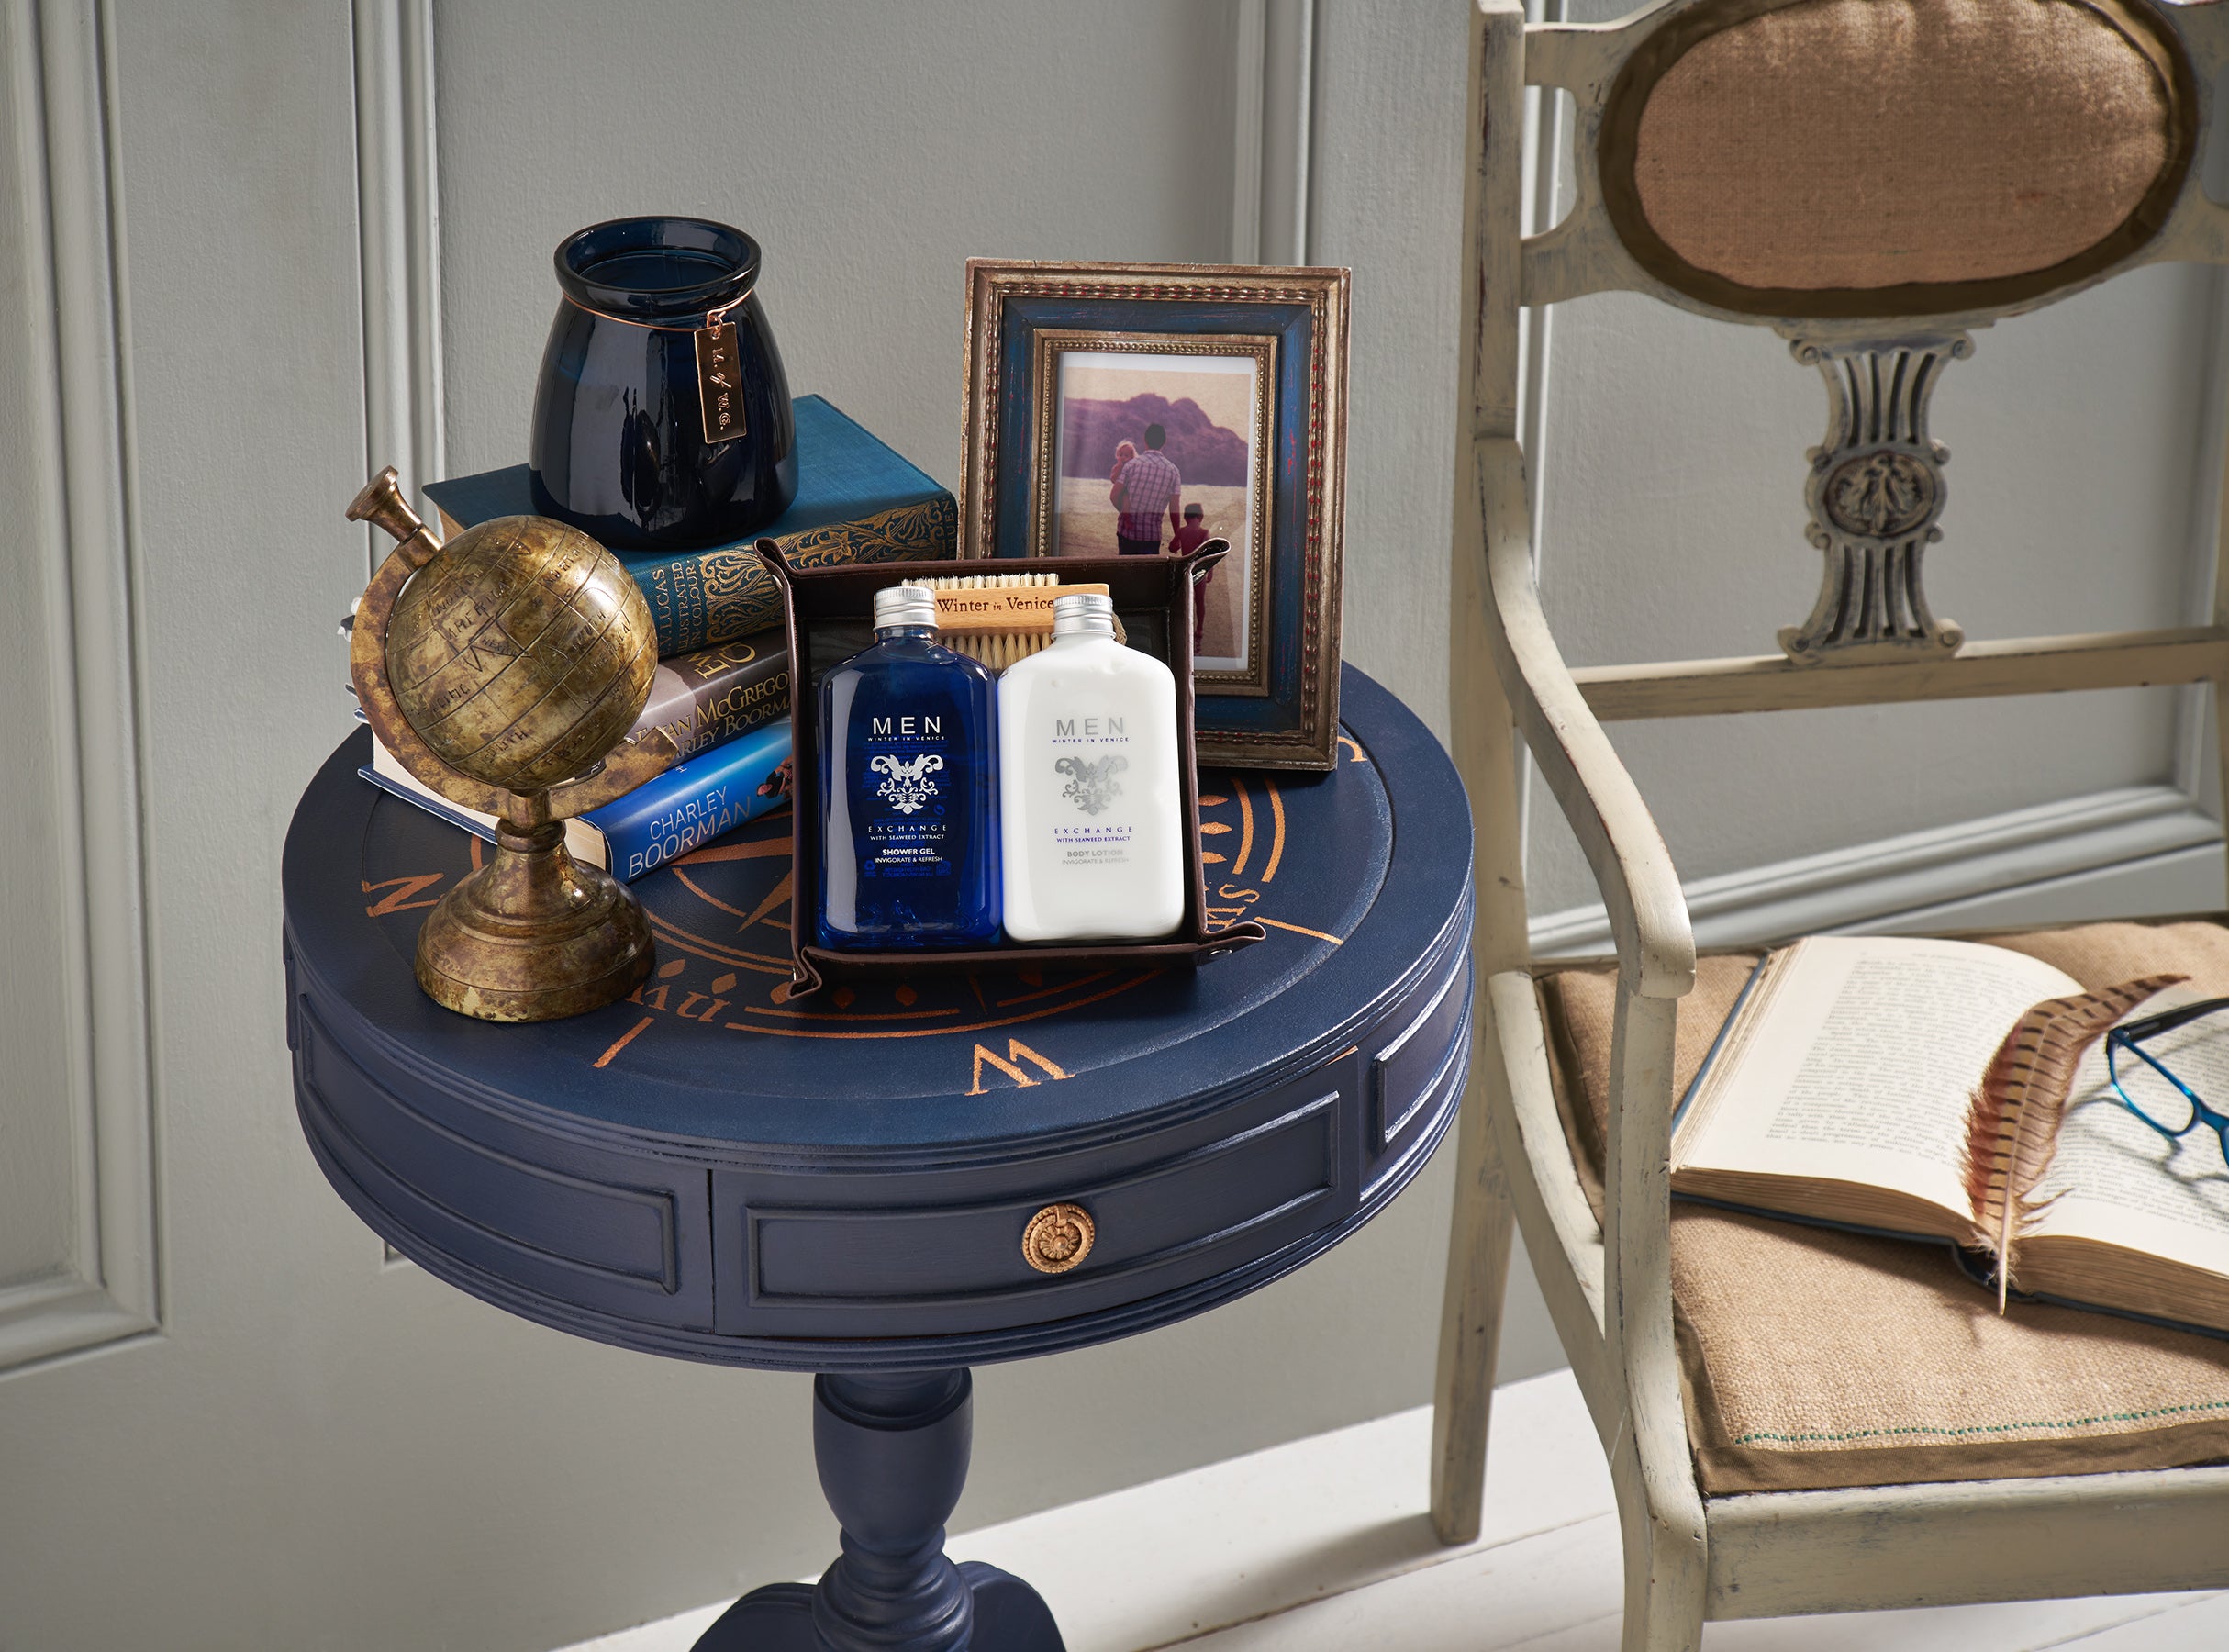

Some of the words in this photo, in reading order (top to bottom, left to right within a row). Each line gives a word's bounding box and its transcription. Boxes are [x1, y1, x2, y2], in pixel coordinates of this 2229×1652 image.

[937, 598, 989, 613] Winter
[993, 602, 1002, 611] in
[1006, 597, 1053, 611] Venice
[873, 716, 941, 734] MEN
[1056, 717, 1124, 736] MEN
[650, 786, 727, 840] CHARLEY
[629, 796, 751, 878] BOORMAN
[362, 873, 445, 918] N
[964, 1038, 1076, 1096] W
